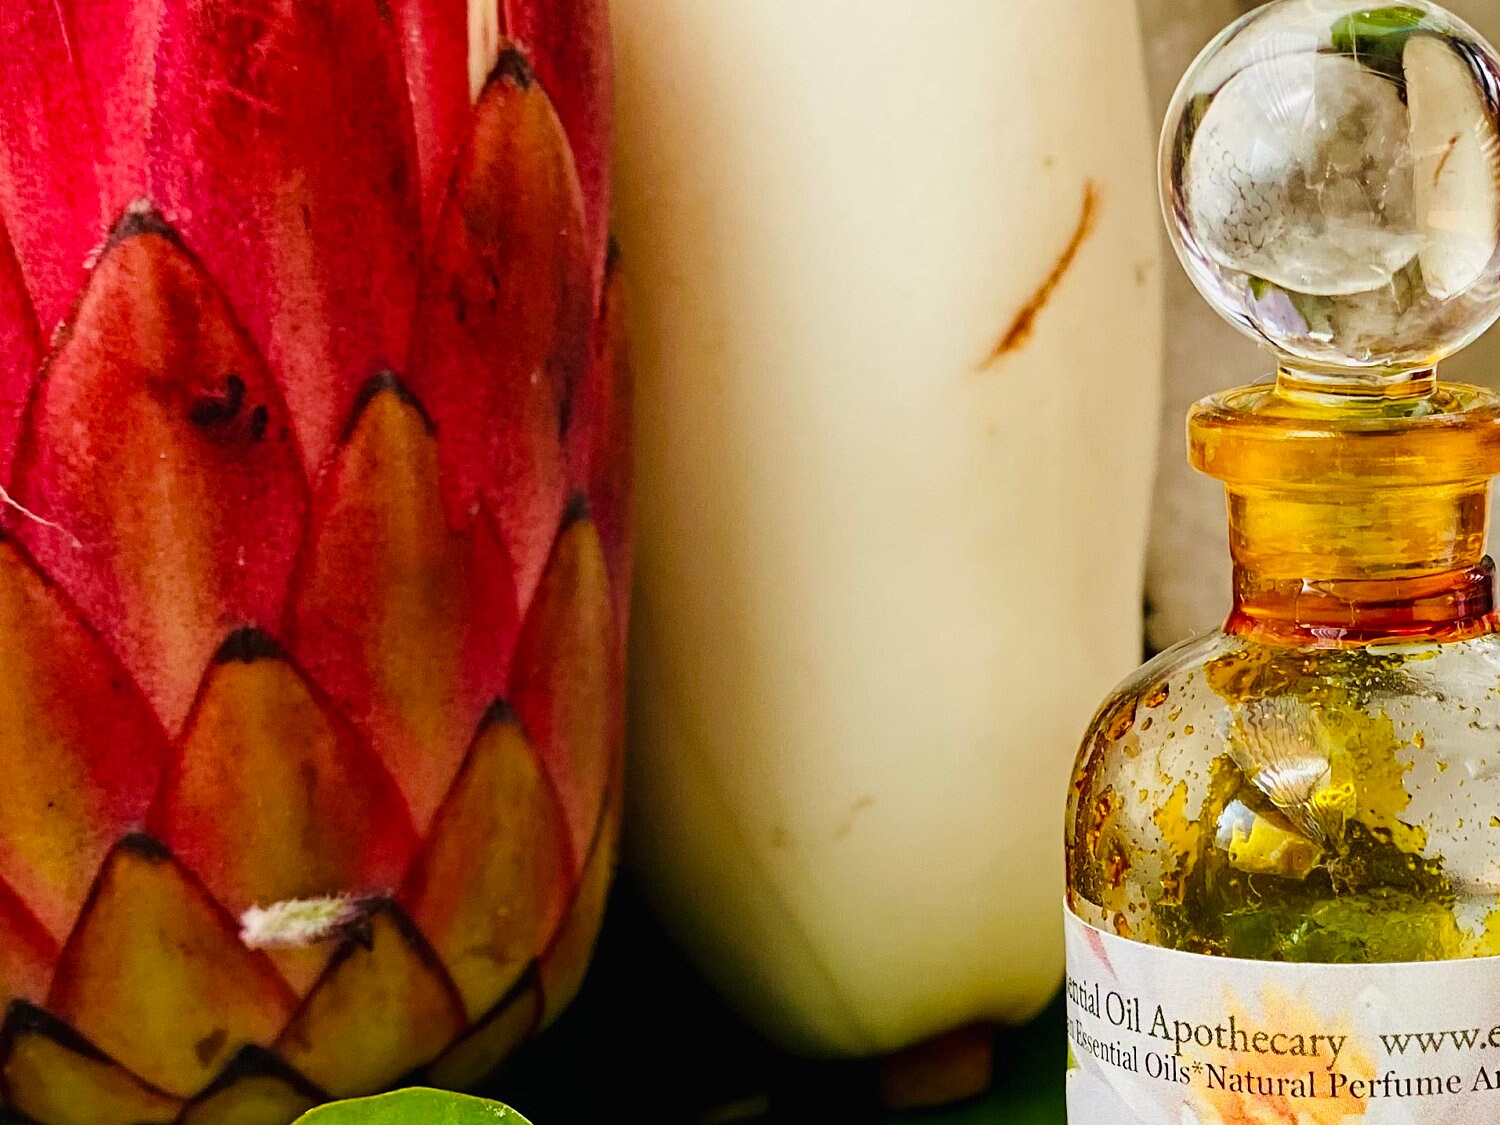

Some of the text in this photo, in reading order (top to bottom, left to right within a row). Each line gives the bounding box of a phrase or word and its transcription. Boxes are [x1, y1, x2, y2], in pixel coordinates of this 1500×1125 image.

[1066, 976, 1100, 1019] ential
[1106, 991, 1141, 1033] Oil
[1148, 1004, 1347, 1071] Apothecary
[1076, 1018, 1138, 1073] Essential
[1329, 1071, 1462, 1099] Perfume
